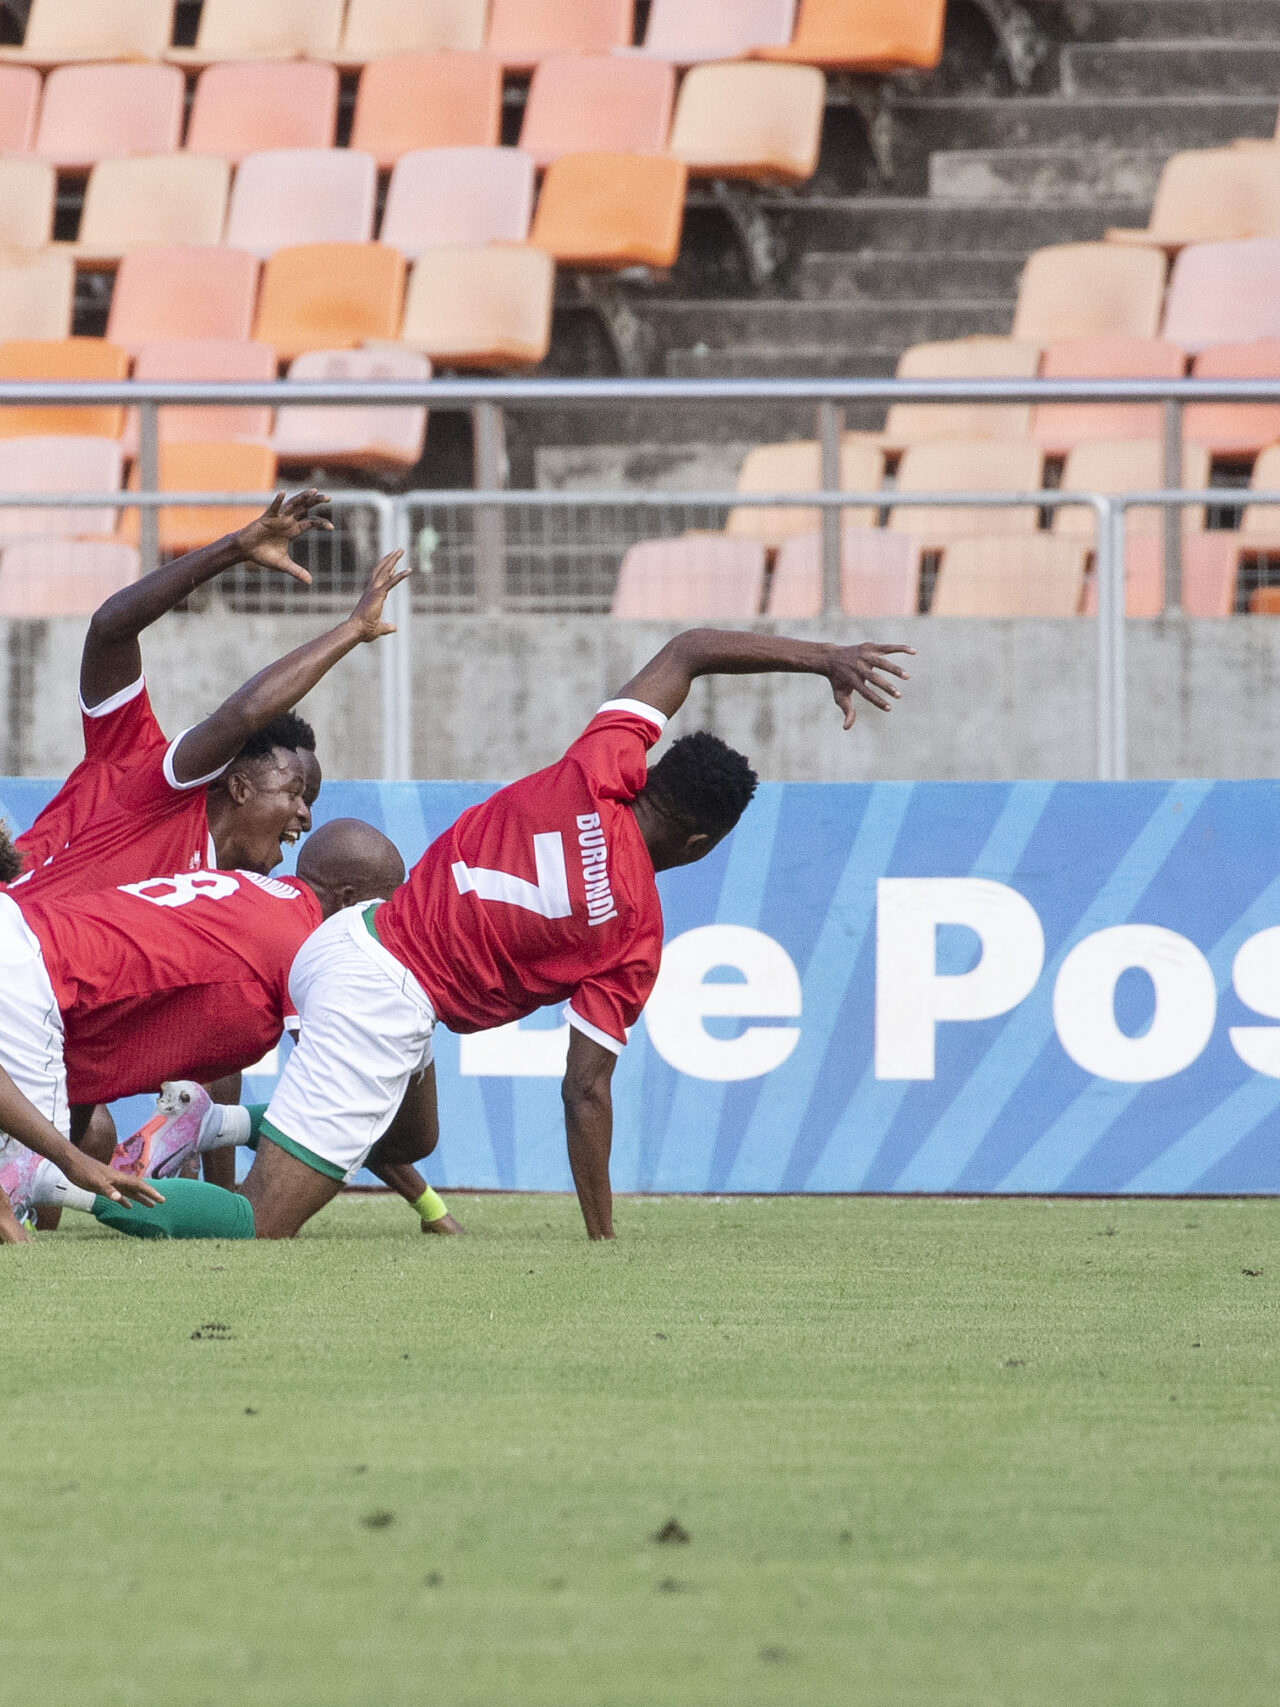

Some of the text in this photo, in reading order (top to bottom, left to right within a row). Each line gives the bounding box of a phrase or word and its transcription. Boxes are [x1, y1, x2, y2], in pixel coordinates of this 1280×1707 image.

[117, 870, 240, 908] 8
[451, 831, 573, 919] 7
[576, 812, 619, 926] BURUNDI
[459, 923, 803, 1082] e
